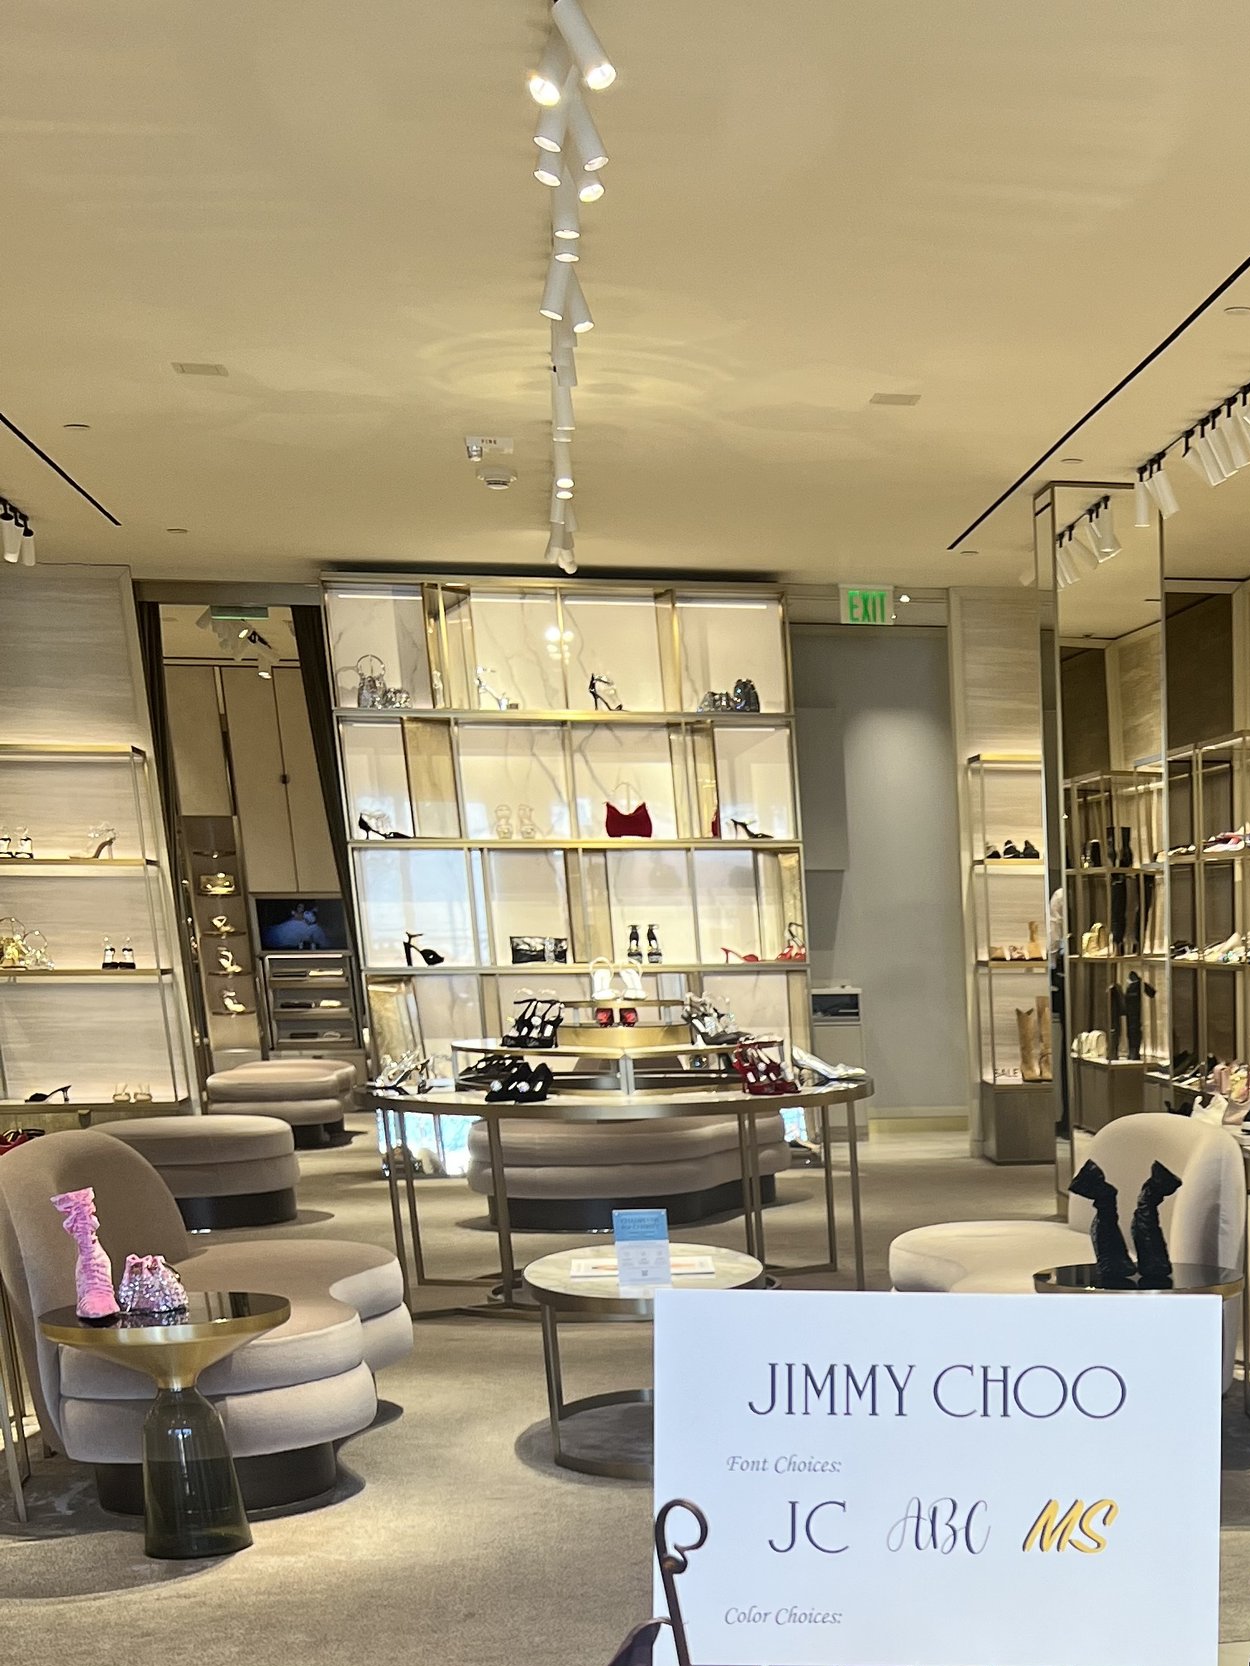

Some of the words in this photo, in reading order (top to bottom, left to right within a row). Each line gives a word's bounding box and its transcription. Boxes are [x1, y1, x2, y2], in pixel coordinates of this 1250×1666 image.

[848, 590, 887, 623] EXIT
[994, 1068, 1019, 1078] SALE
[748, 1362, 916, 1417] JIMMY
[933, 1364, 1128, 1419] CHOO
[726, 1455, 769, 1473] Font
[774, 1454, 842, 1474] Choices:
[768, 1500, 849, 1554] JC
[886, 1497, 992, 1555] ABC
[1022, 1498, 1120, 1554] MS
[724, 1606, 772, 1625] Color
[775, 1605, 843, 1626] Choices:
